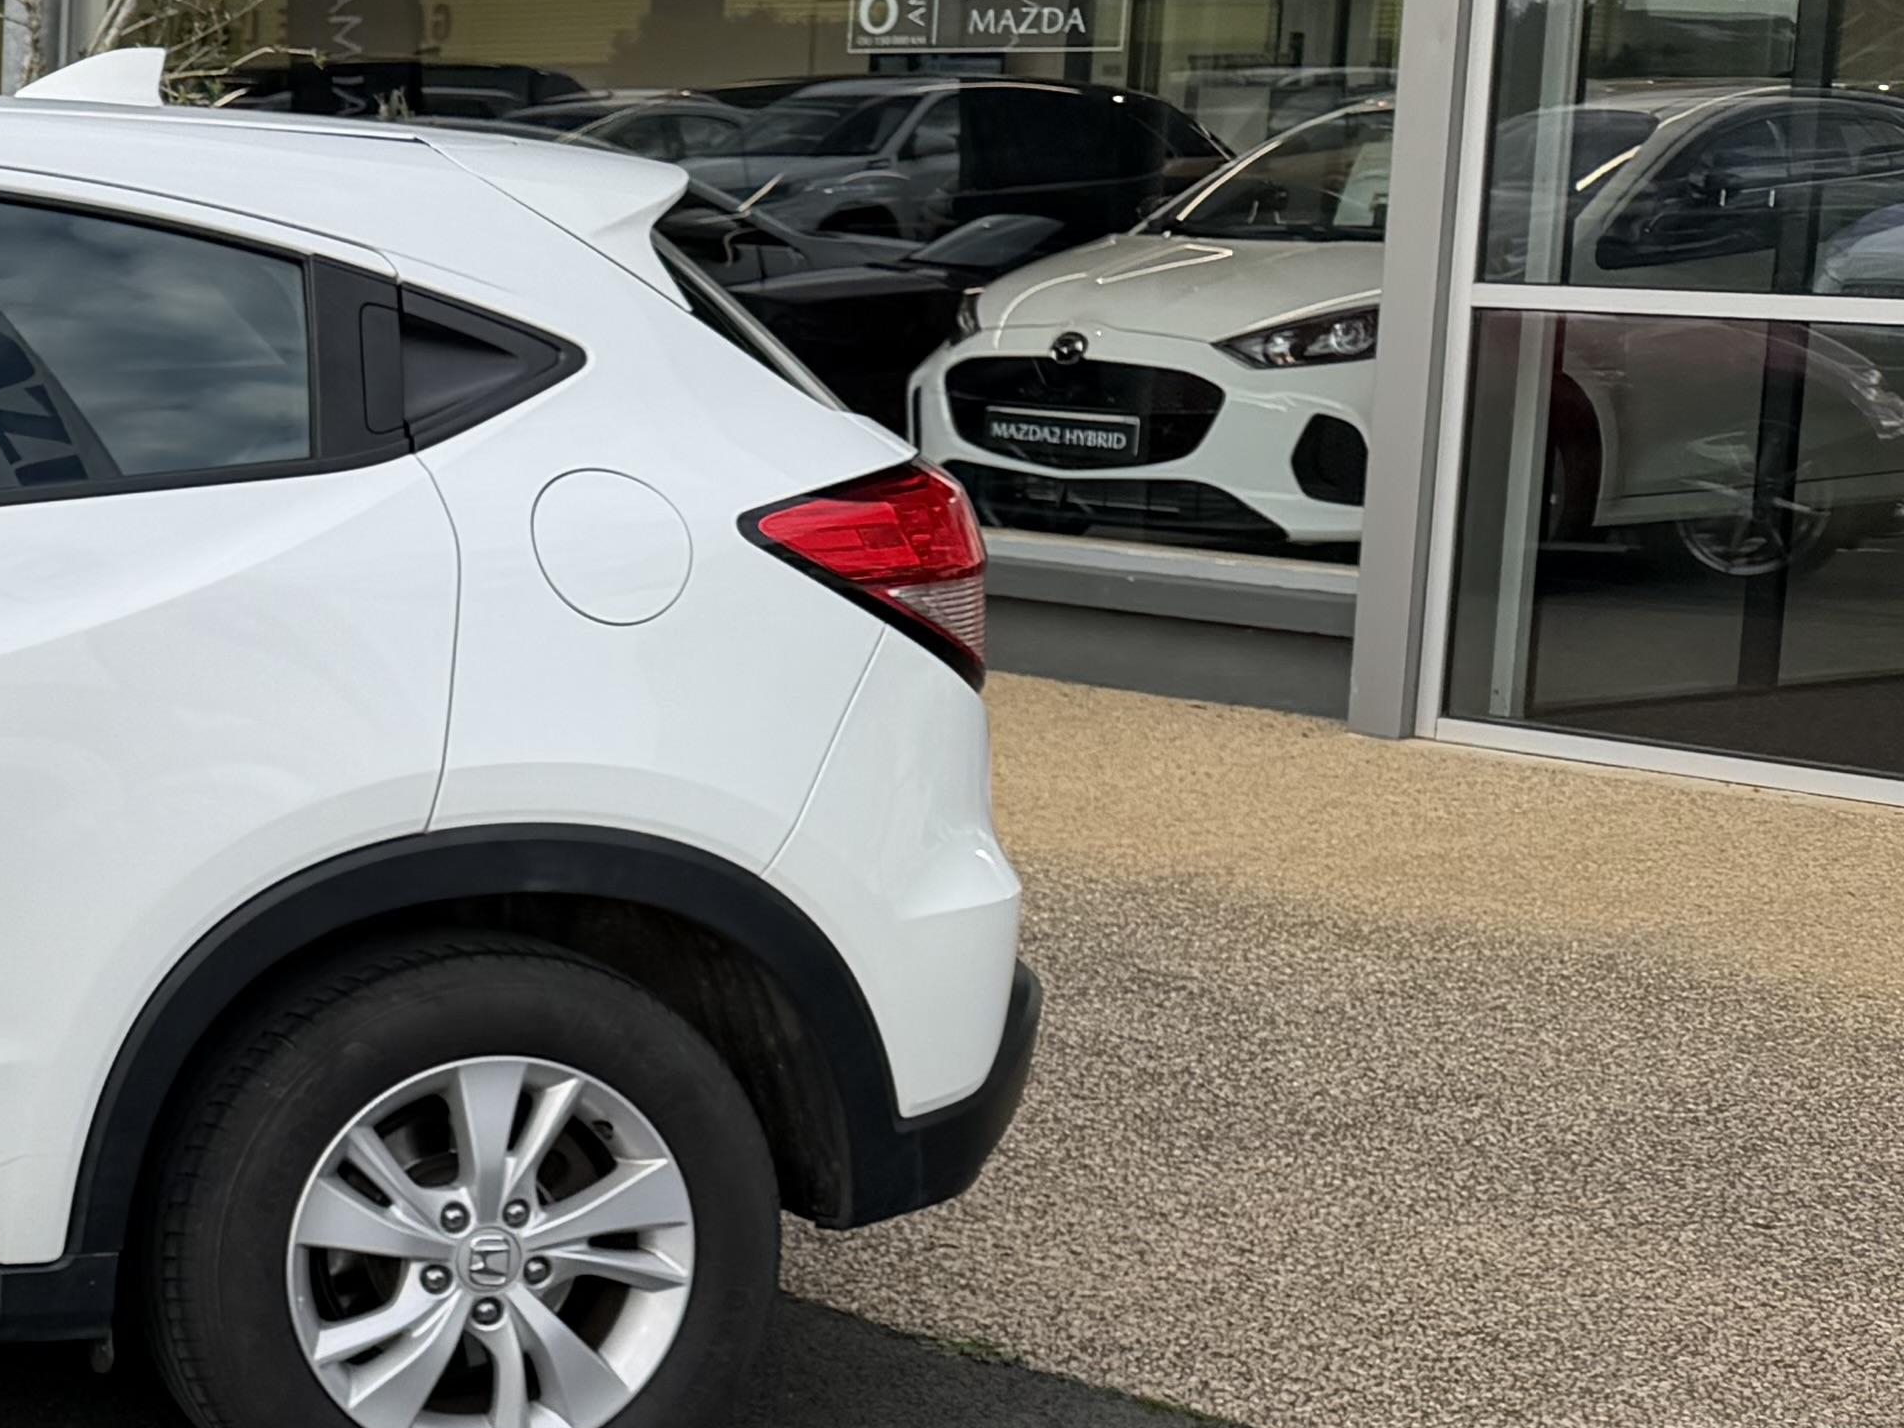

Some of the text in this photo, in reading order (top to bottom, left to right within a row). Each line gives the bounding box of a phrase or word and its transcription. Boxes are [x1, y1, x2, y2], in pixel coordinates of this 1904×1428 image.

[968, 7, 1087, 35] MAZDA
[991, 420, 1127, 450] MAZDA2 HYBRID
